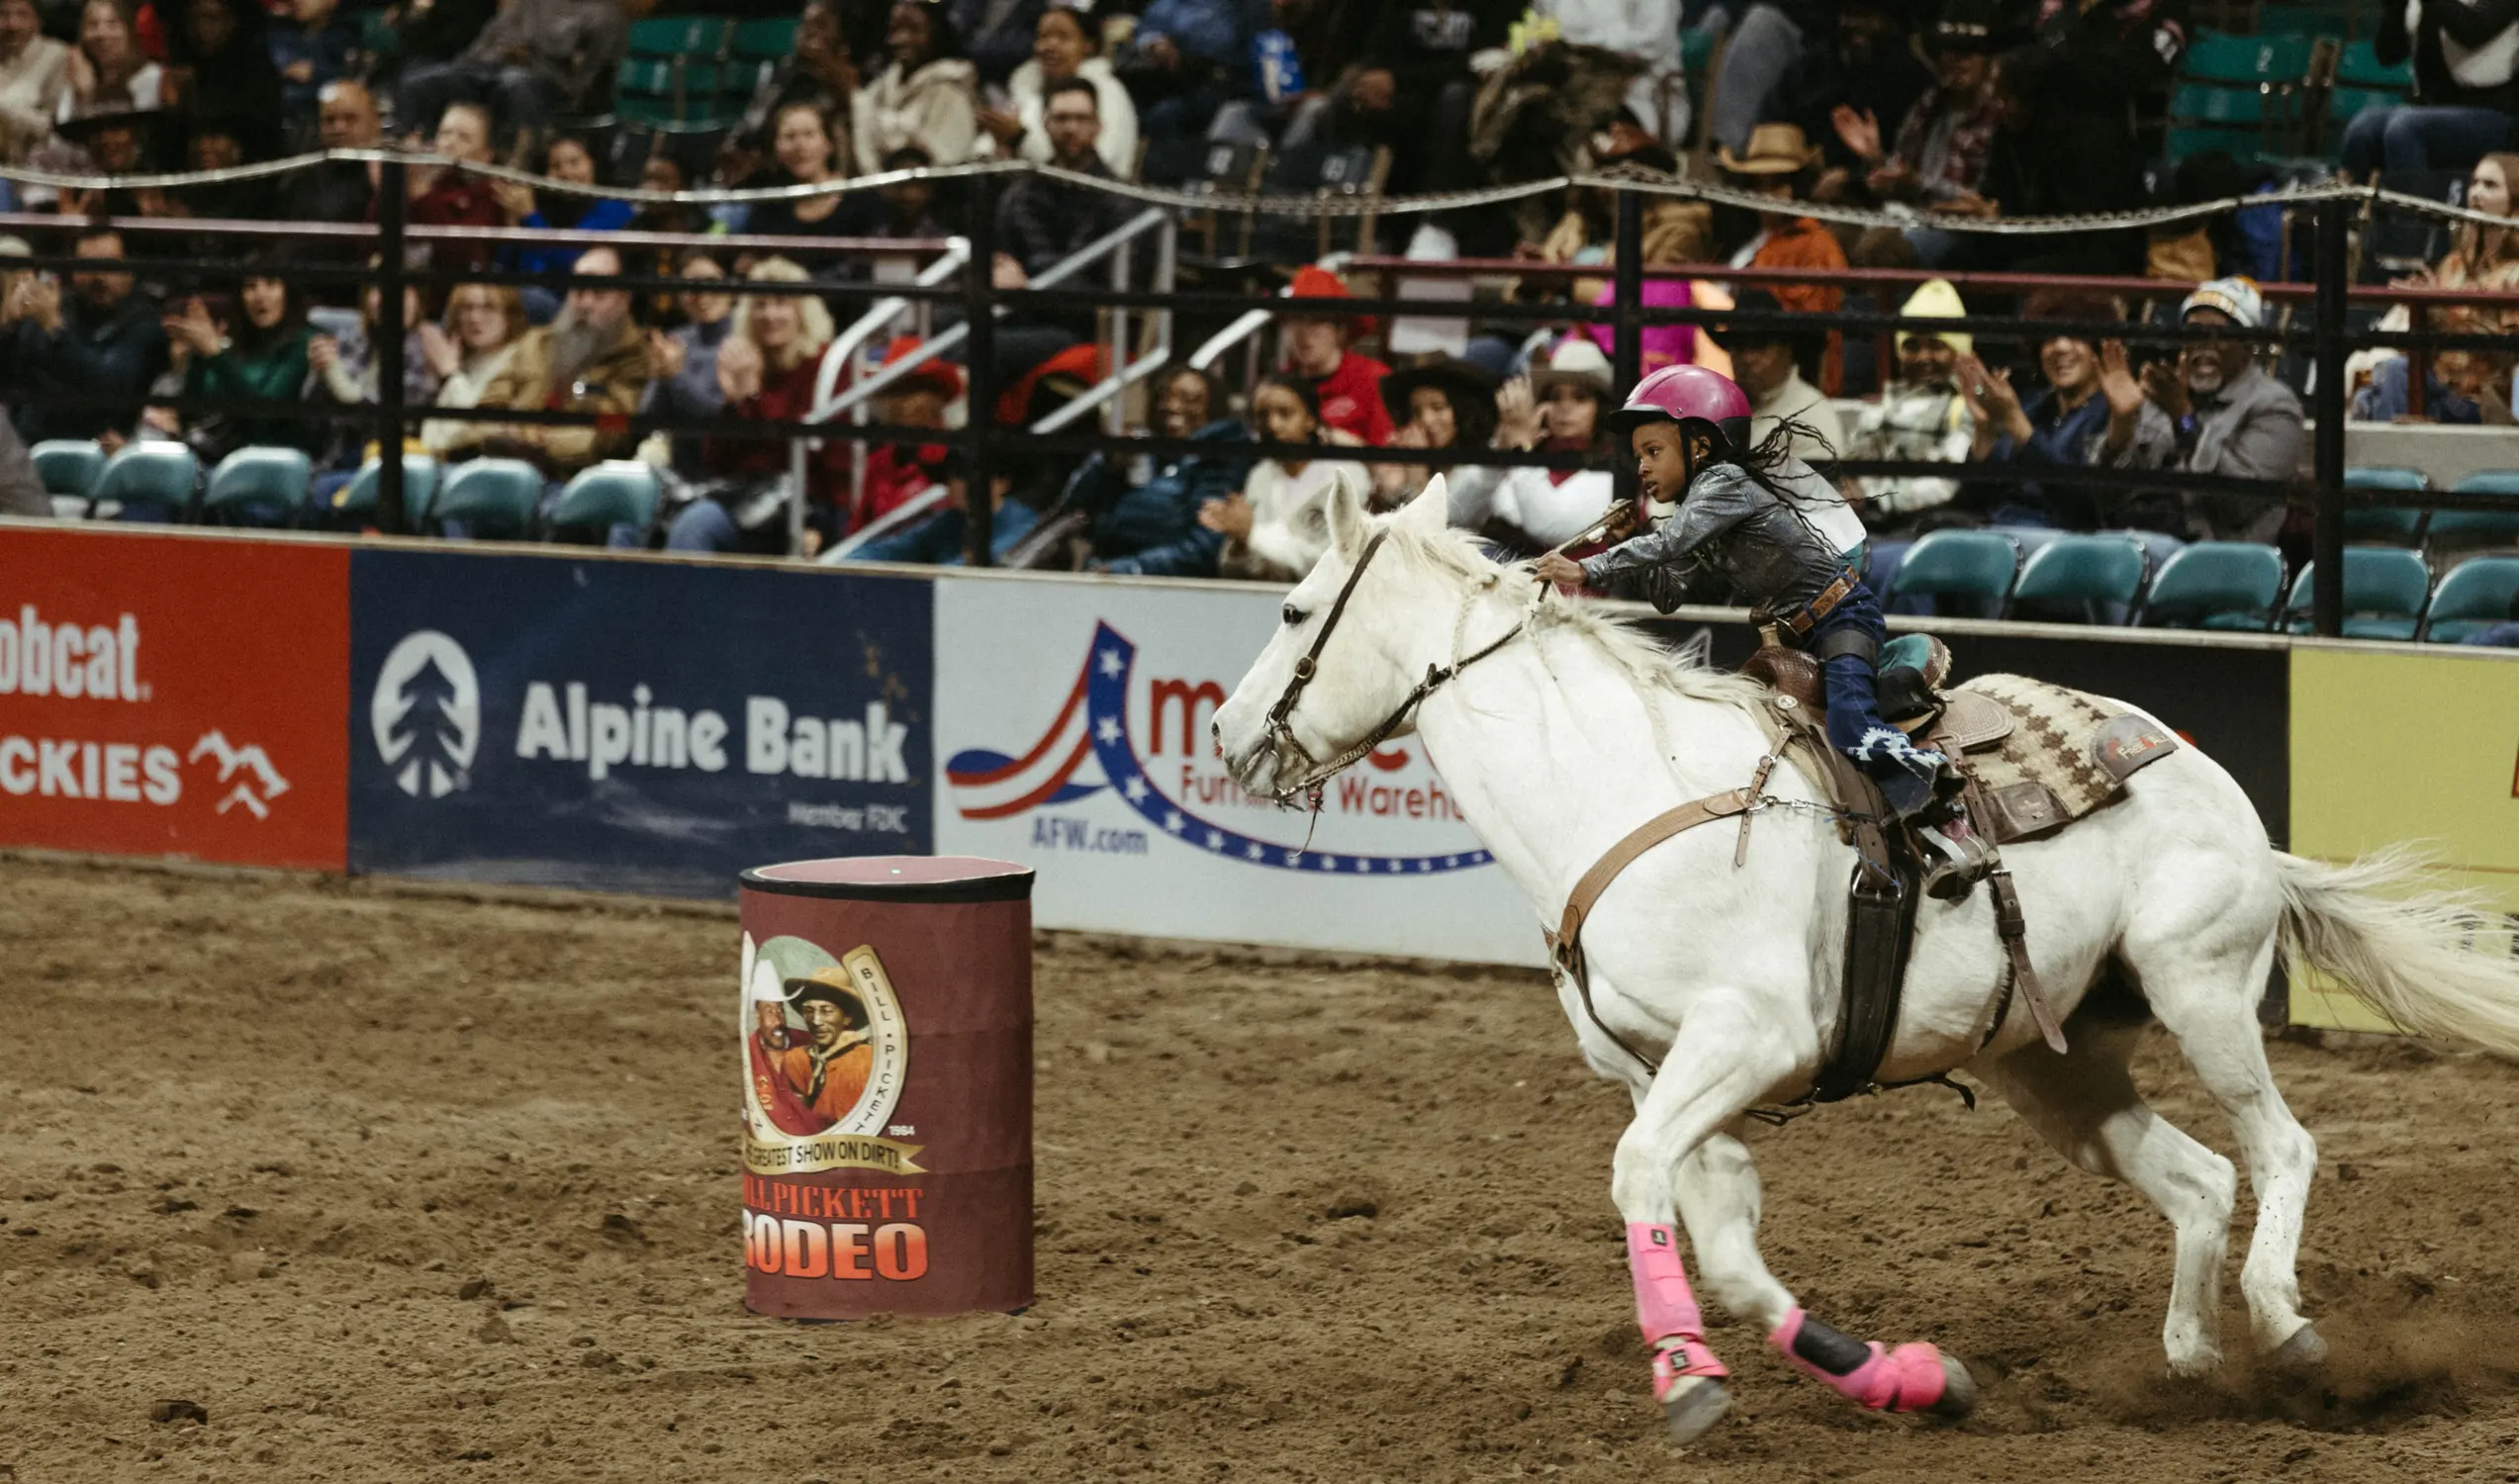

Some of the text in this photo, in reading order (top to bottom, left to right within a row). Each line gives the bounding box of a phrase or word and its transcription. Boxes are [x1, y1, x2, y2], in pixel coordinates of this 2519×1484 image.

[515, 681, 729, 781] Alpine
[746, 695, 909, 785] Bank
[1031, 817, 1148, 854] AFW.com
[853, 967, 897, 1134] BILL PICKETT
[795, 1142, 836, 1164] SHOW
[838, 1141, 859, 1160] ON
[862, 1142, 899, 1169] DIRT!
[773, 1181, 923, 1219] PICKETT
